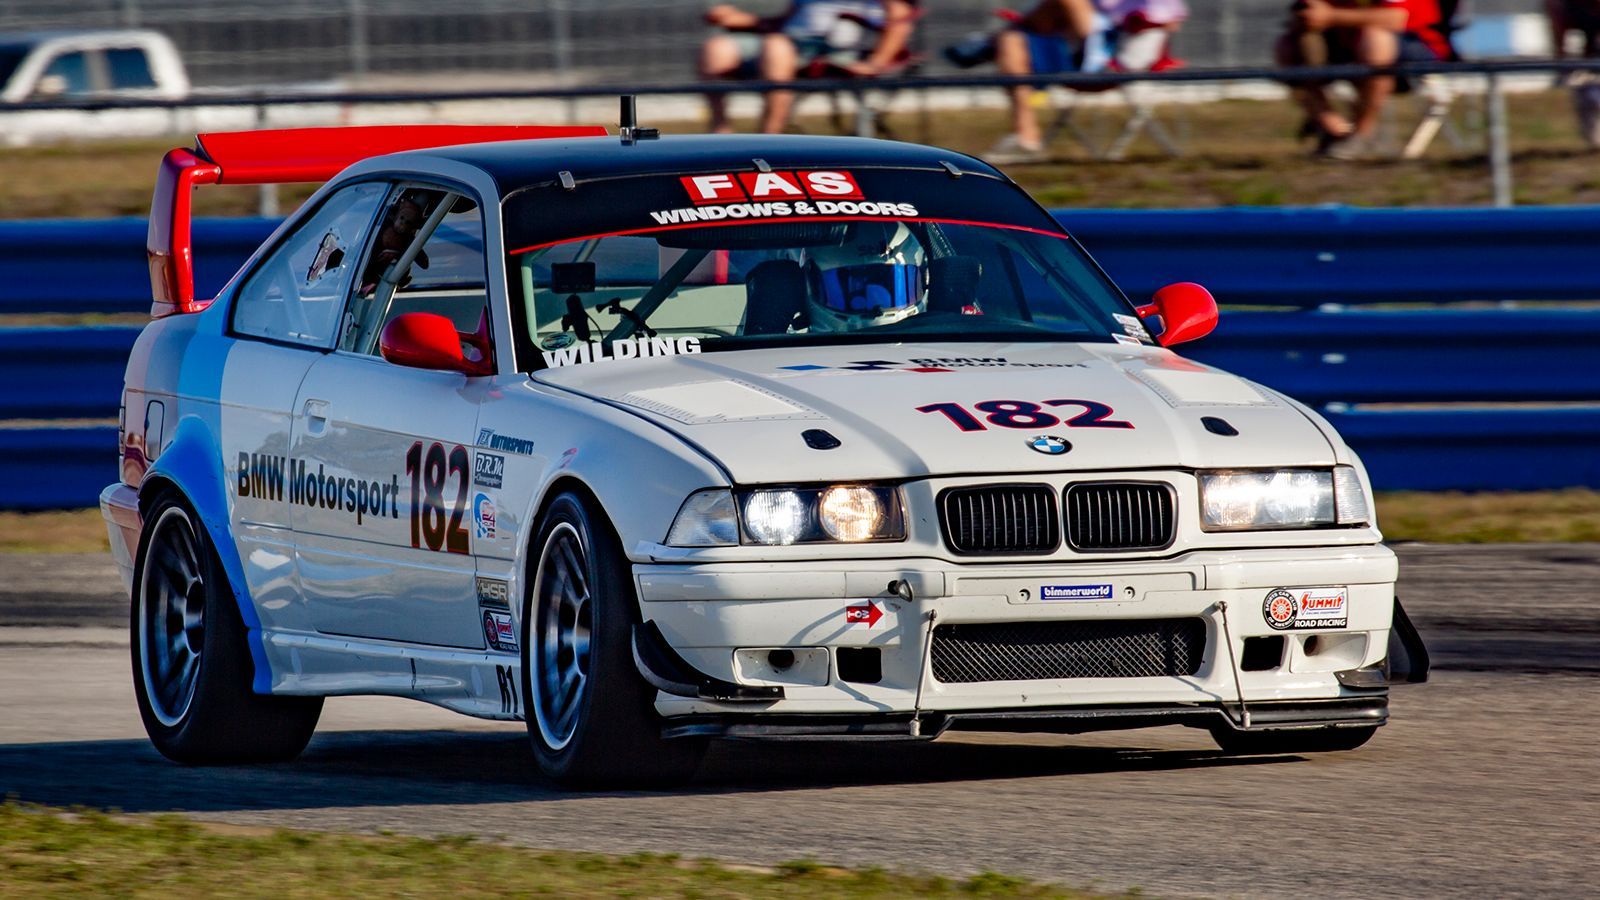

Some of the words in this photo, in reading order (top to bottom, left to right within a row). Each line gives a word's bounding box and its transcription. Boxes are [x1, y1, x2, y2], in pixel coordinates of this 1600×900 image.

[691, 171, 854, 199] FAS
[650, 201, 792, 225] WINDOWS
[794, 201, 817, 215] &
[816, 201, 919, 217] DOORS
[542, 336, 701, 368] WILDING
[915, 398, 1135, 432] 182
[238, 451, 285, 502] BMW
[289, 458, 399, 525] Motorsport
[406, 440, 470, 555] 182
[1044, 585, 1110, 597] bimmerworld
[1294, 619, 1317, 628] ROAD
[1317, 618, 1346, 627] RACING
[495, 664, 518, 713] R1
